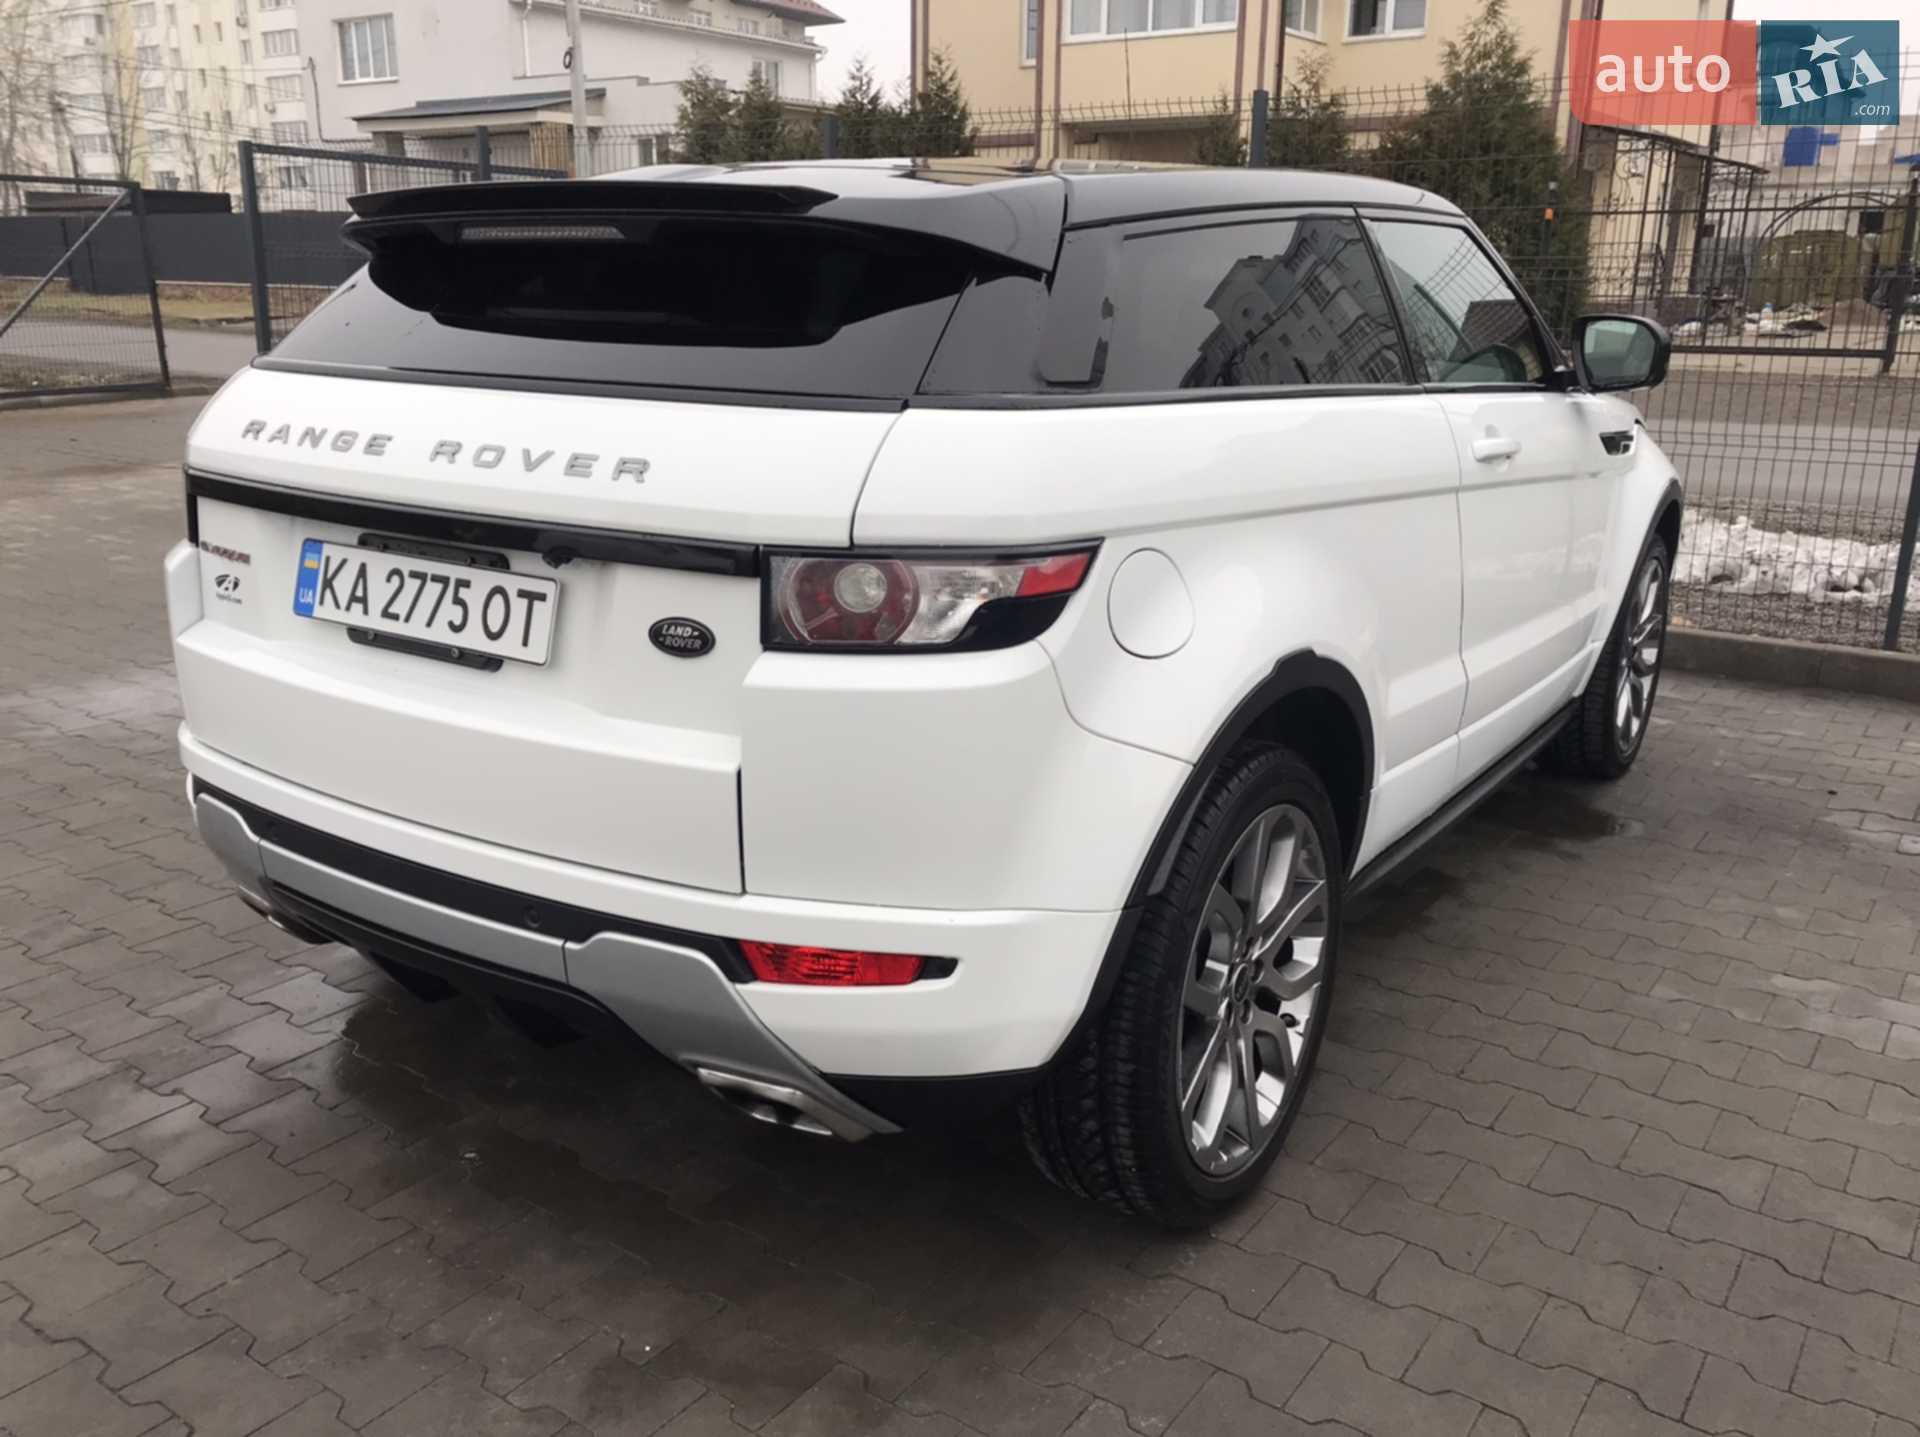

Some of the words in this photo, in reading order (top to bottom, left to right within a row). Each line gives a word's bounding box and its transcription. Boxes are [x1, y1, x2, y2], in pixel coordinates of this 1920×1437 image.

[241, 418, 394, 457] RANGE
[429, 438, 651, 483] ROVER
[299, 587, 314, 605] UA
[318, 554, 369, 617] KA
[380, 567, 472, 634] 2775
[481, 584, 548, 648] OT
[661, 624, 692, 638] LAND
[664, 635, 702, 650] ROVER
